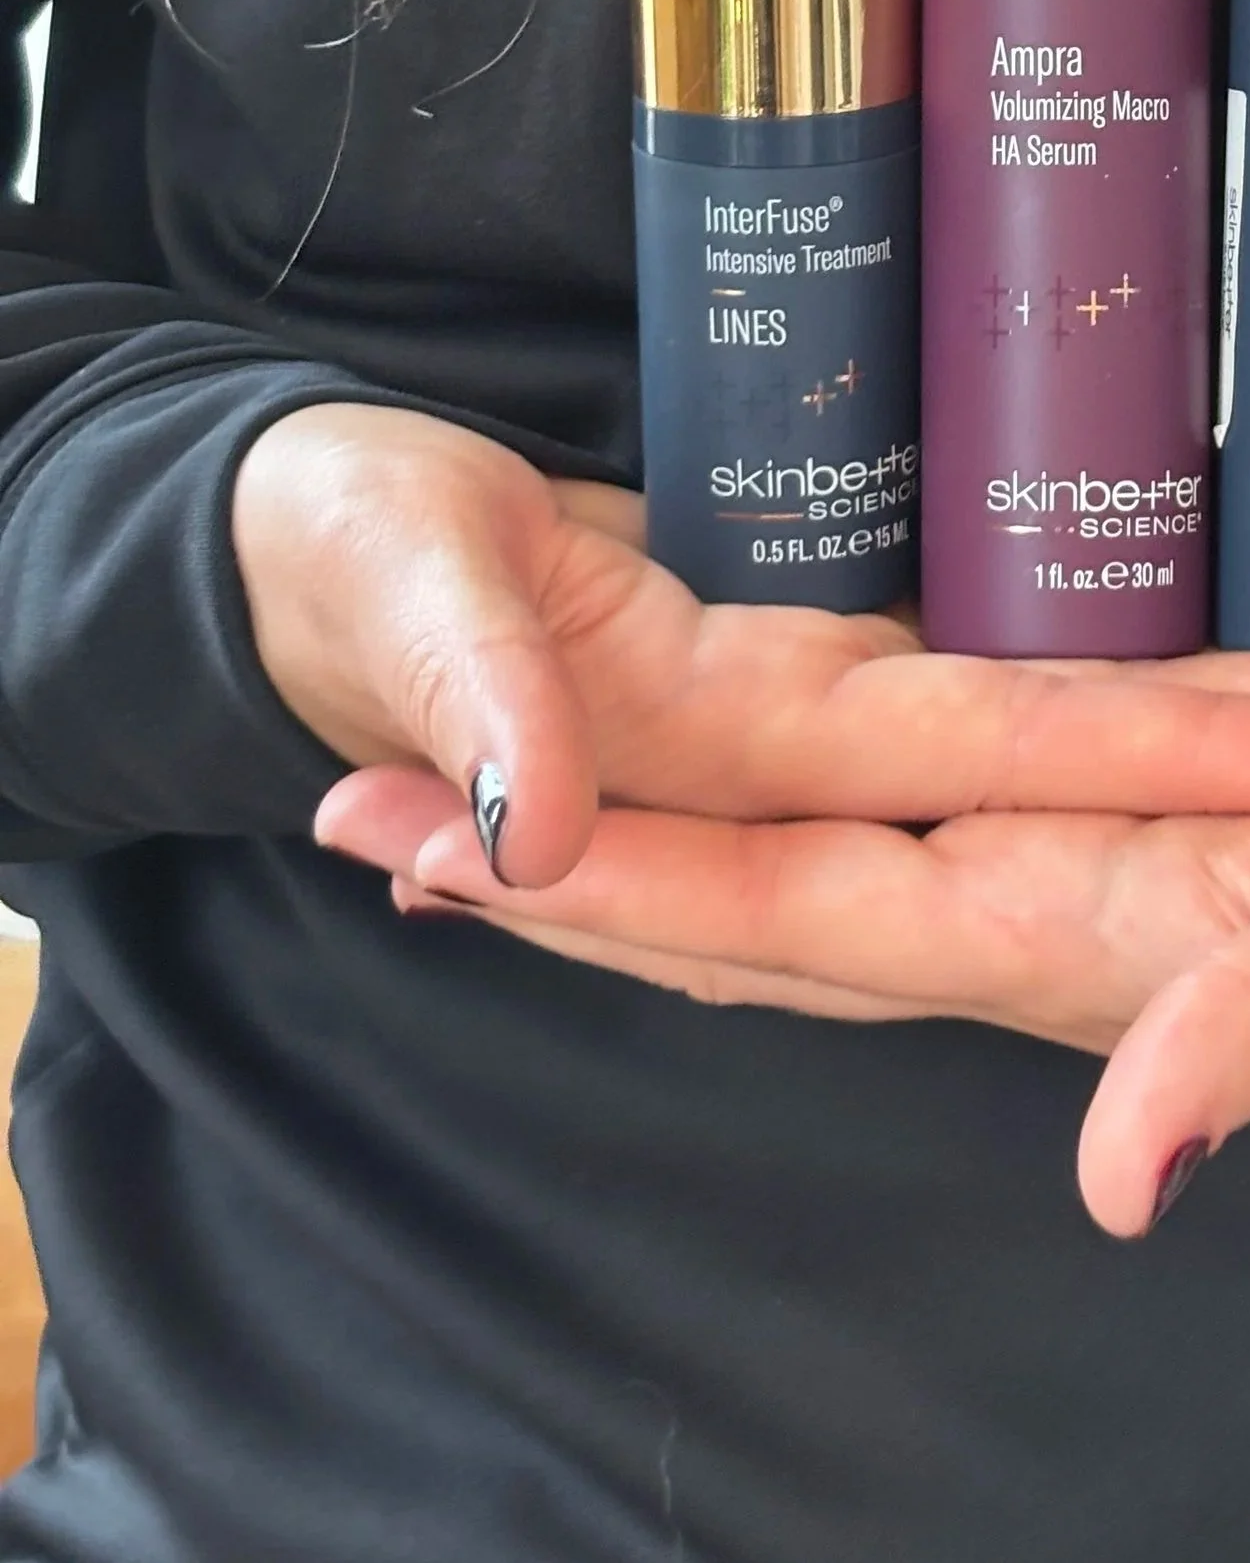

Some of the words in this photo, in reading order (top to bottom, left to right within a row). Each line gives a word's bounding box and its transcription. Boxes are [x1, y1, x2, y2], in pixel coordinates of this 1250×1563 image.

[990, 36, 1083, 86] Ampra
[990, 89, 1106, 129] Volumizing
[1111, 90, 1170, 121] Macro
[991, 134, 1021, 166] HA
[1026, 134, 1097, 166] Serum
[705, 244, 797, 275] Intensive
[800, 236, 892, 274] Treatment
[708, 306, 788, 347] LINES
[710, 443, 919, 499] skinbette
[986, 469, 1202, 512] skinbetter
[752, 539, 784, 563] 0.5
[787, 539, 814, 563] FL.
[818, 534, 847, 560] OZ.
[874, 524, 891, 549] 15
[1034, 563, 1044, 589] 1
[1049, 561, 1069, 589] fl.
[1073, 569, 1099, 589] oz.
[1131, 562, 1152, 587] 30
[1156, 559, 1174, 586] ml
